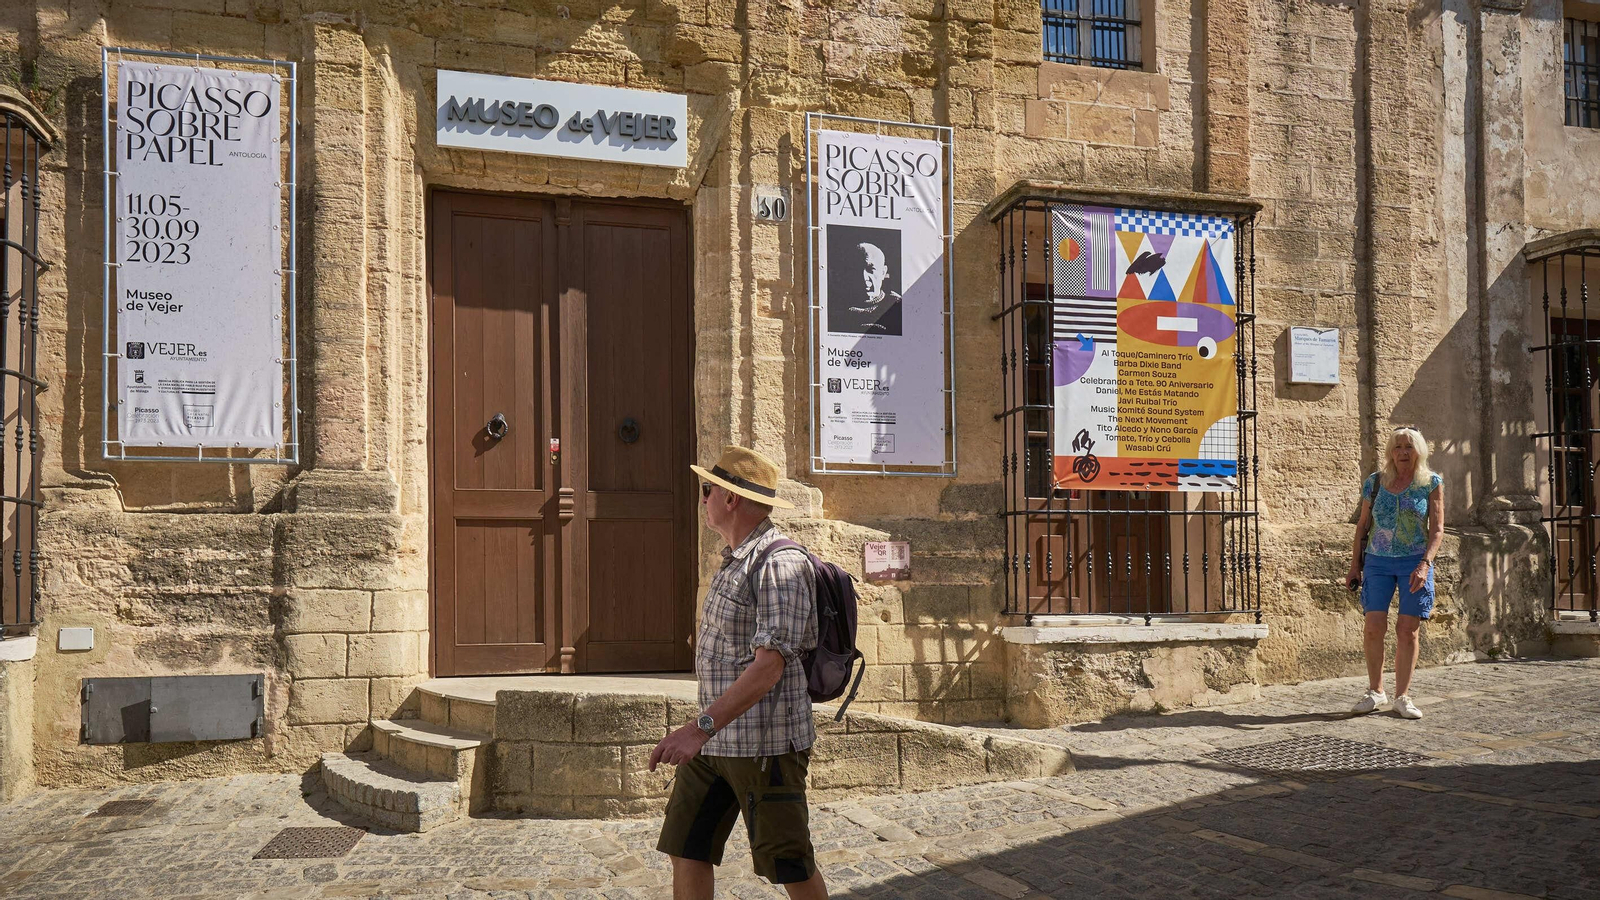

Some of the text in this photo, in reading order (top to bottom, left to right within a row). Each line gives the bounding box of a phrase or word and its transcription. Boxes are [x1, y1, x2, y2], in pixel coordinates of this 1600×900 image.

[127, 80, 272, 118] PICASSO
[126, 106, 241, 142] SOBRE
[446, 95, 678, 142] MUSEO de VEJER
[126, 133, 268, 166] PAPEL ANTOLOGÍA
[826, 143, 938, 178] PICASSO
[825, 167, 915, 199] SOBRE
[126, 192, 190, 217] 11.05-
[826, 190, 902, 221] PAPEL
[126, 216, 200, 242] 30.09
[126, 240, 191, 265] 2023
[126, 289, 173, 301] Museo
[126, 301, 184, 315] de Vejer
[146, 342, 208, 357] VEJER.es
[827, 347, 863, 358] Museo
[1112, 350, 1176, 361] Toque/Caminero
[1178, 353, 1194, 361] Trío
[827, 358, 872, 370] de Vejer
[1114, 360, 1182, 370] Barba Dixie Band
[1118, 370, 1177, 378] Carmen Souza
[842, 378, 890, 392] VEJER.es
[1080, 376, 1127, 386] Celebrando
[1168, 381, 1214, 390] Aniversario
[1096, 386, 1123, 396] Daniel,
[1138, 388, 1162, 396] Estás
[1164, 390, 1200, 398] Matando
[1118, 396, 1178, 406] Javi Ruibal Trío
[1090, 405, 1204, 417] Music Komité Sound System
[1124, 416, 1144, 424] Next
[1146, 416, 1188, 425] Movement
[1114, 425, 1142, 433] Alcedo
[1173, 427, 1198, 435] García
[1105, 434, 1137, 443] Tomate,
[1138, 434, 1153, 442] Trío
[1161, 436, 1191, 444] Cebolla
[1126, 444, 1172, 452] Wasabi Crú
